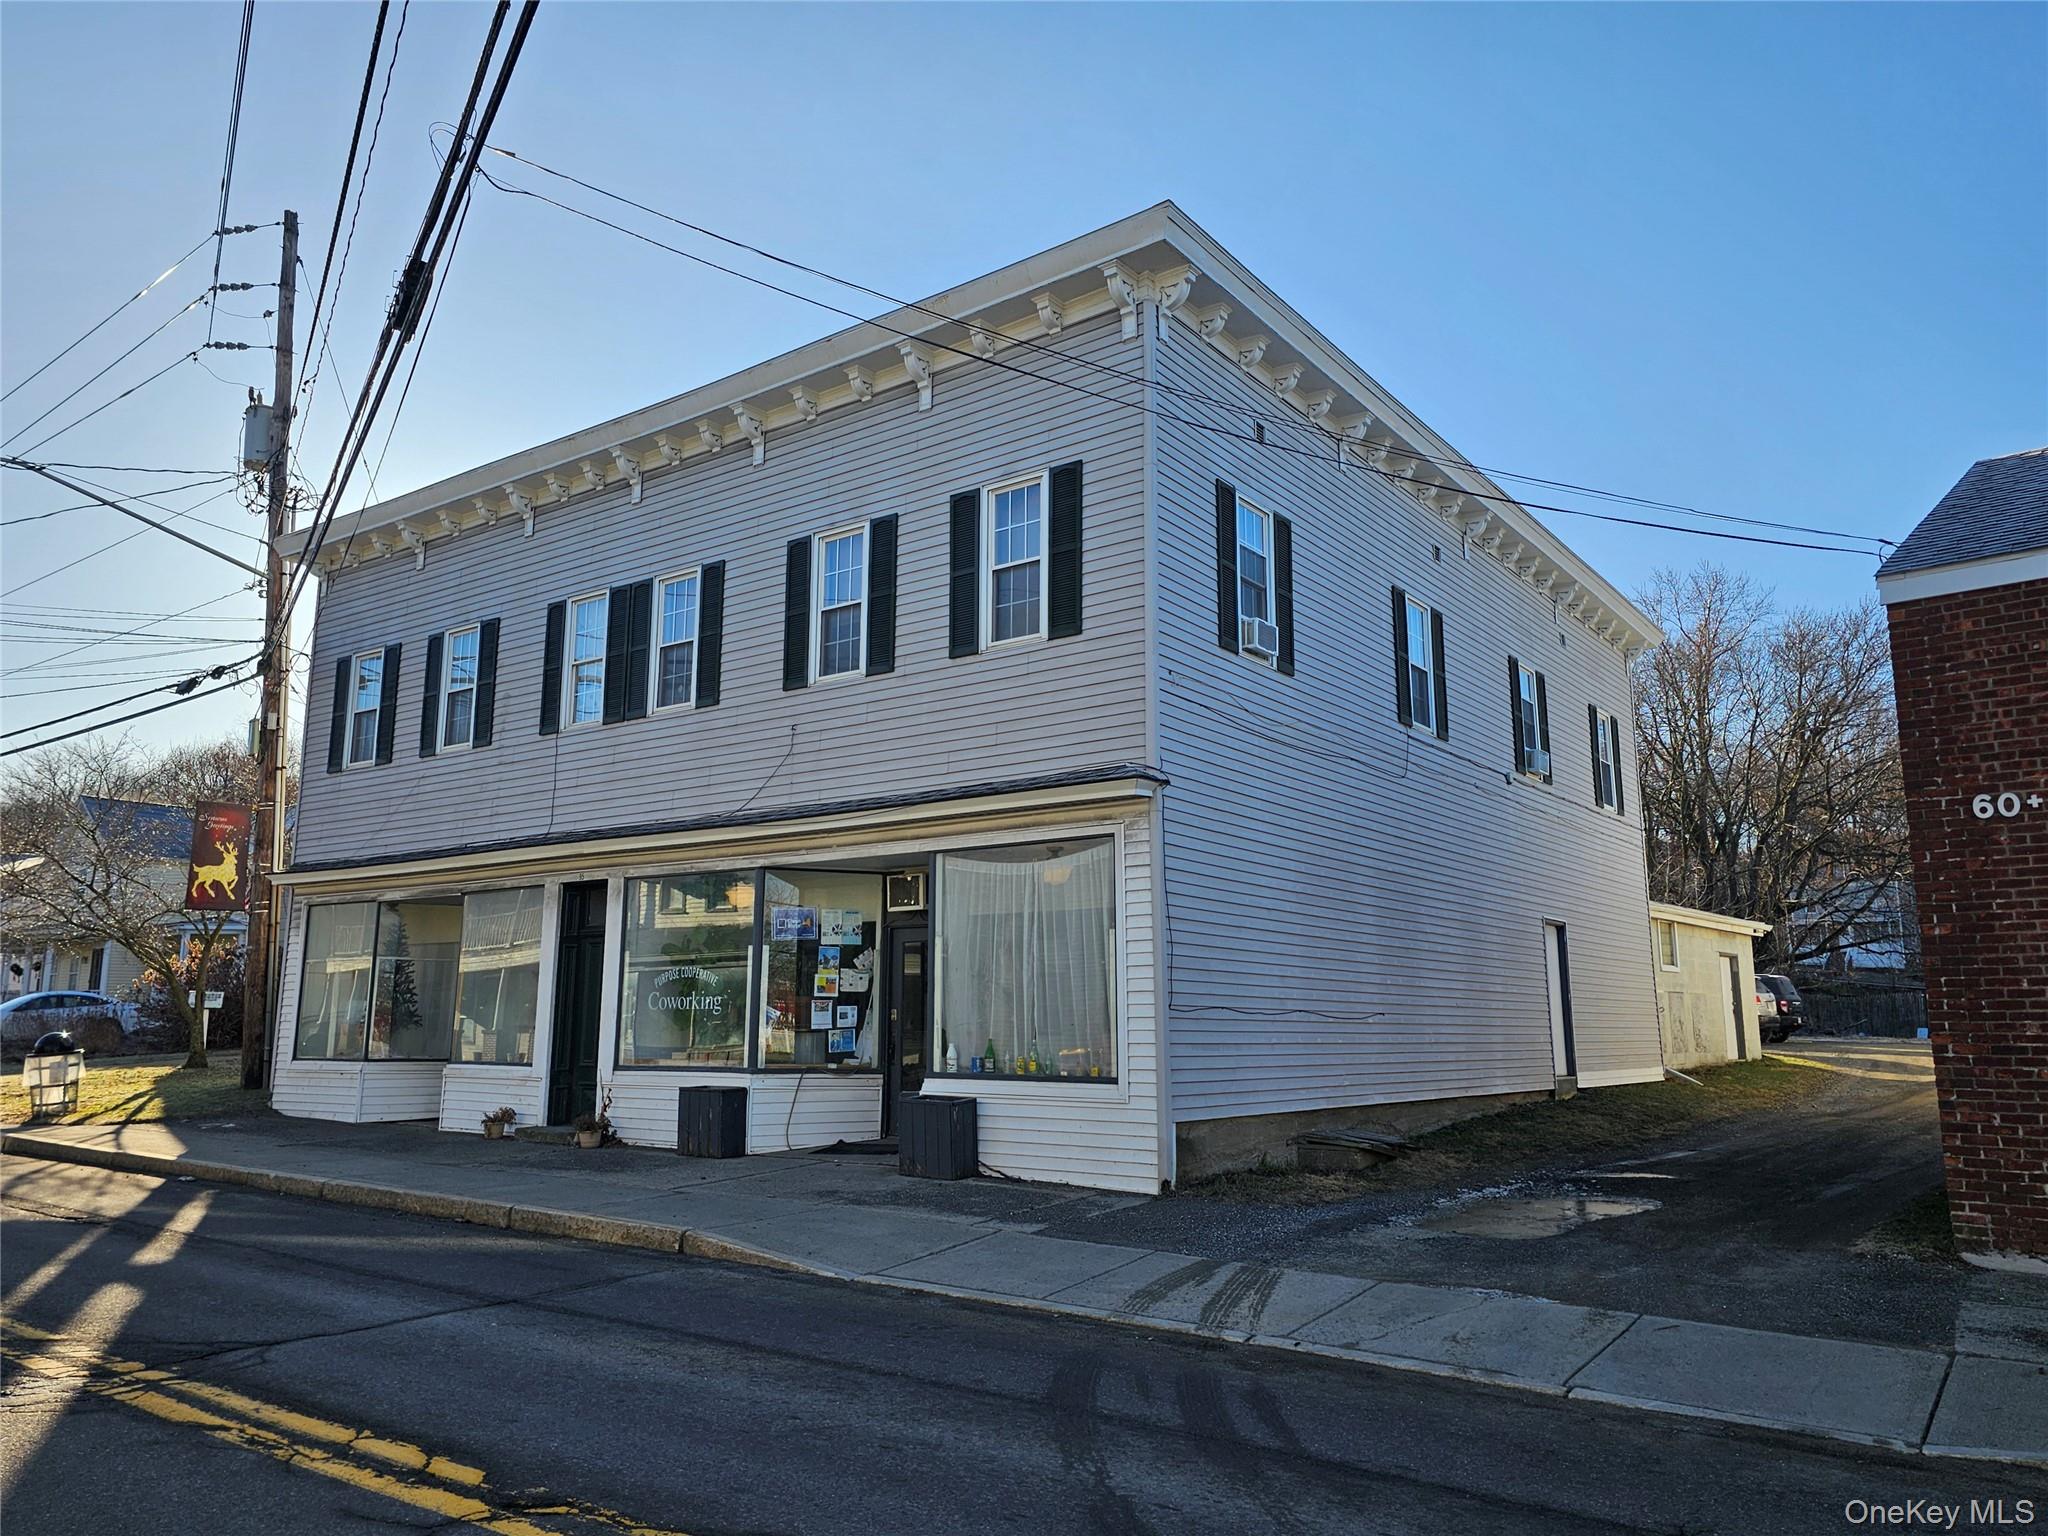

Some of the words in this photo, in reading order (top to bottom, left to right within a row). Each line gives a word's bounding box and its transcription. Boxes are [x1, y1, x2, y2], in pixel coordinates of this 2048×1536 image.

[654, 967, 680, 988] PURPOSE
[680, 966, 719, 987] COOPERATIVE
[648, 991, 722, 1015] Coworking
